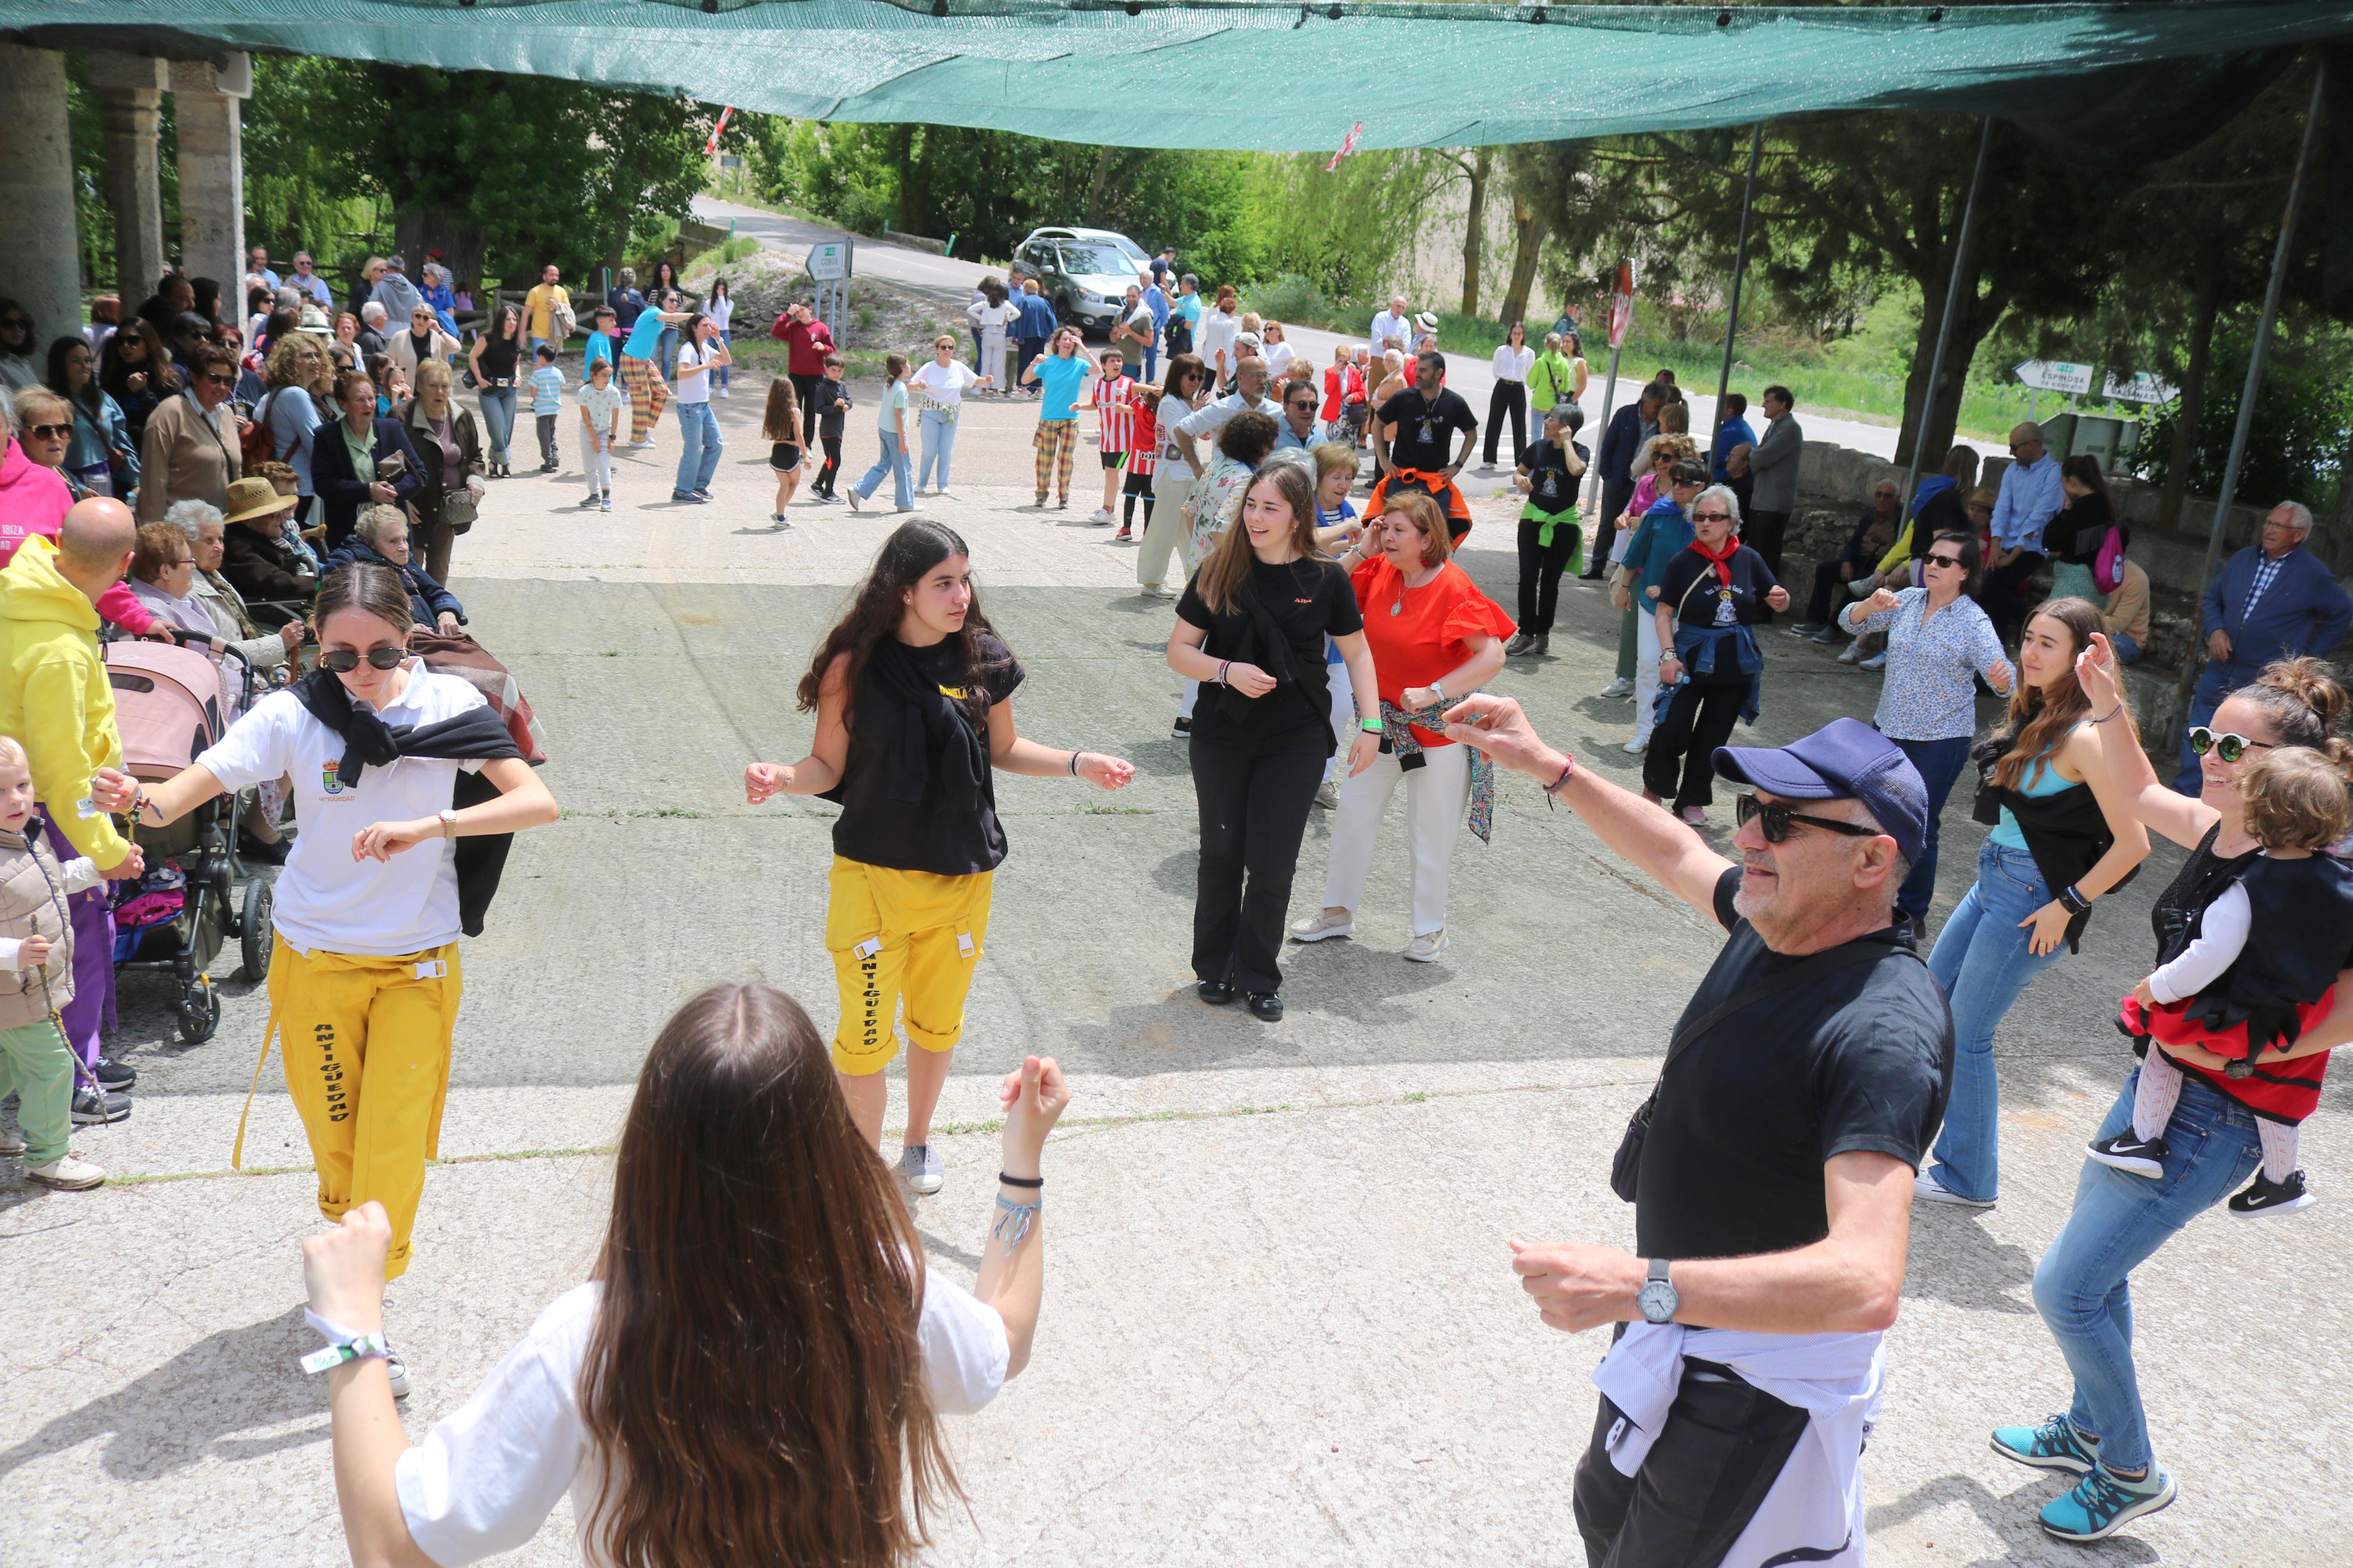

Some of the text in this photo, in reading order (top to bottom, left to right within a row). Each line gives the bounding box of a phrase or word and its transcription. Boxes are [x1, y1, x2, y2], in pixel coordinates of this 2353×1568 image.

[821, 257, 838, 265] COBOS
[1611, 292, 1630, 311] STOP
[2042, 372, 2084, 383] ESPINOSA
[2, 524, 24, 535] IBIZA
[861, 954, 881, 1046] ANTIGÜEDAD
[314, 1024, 349, 1122] ANTIGÜEDAD
